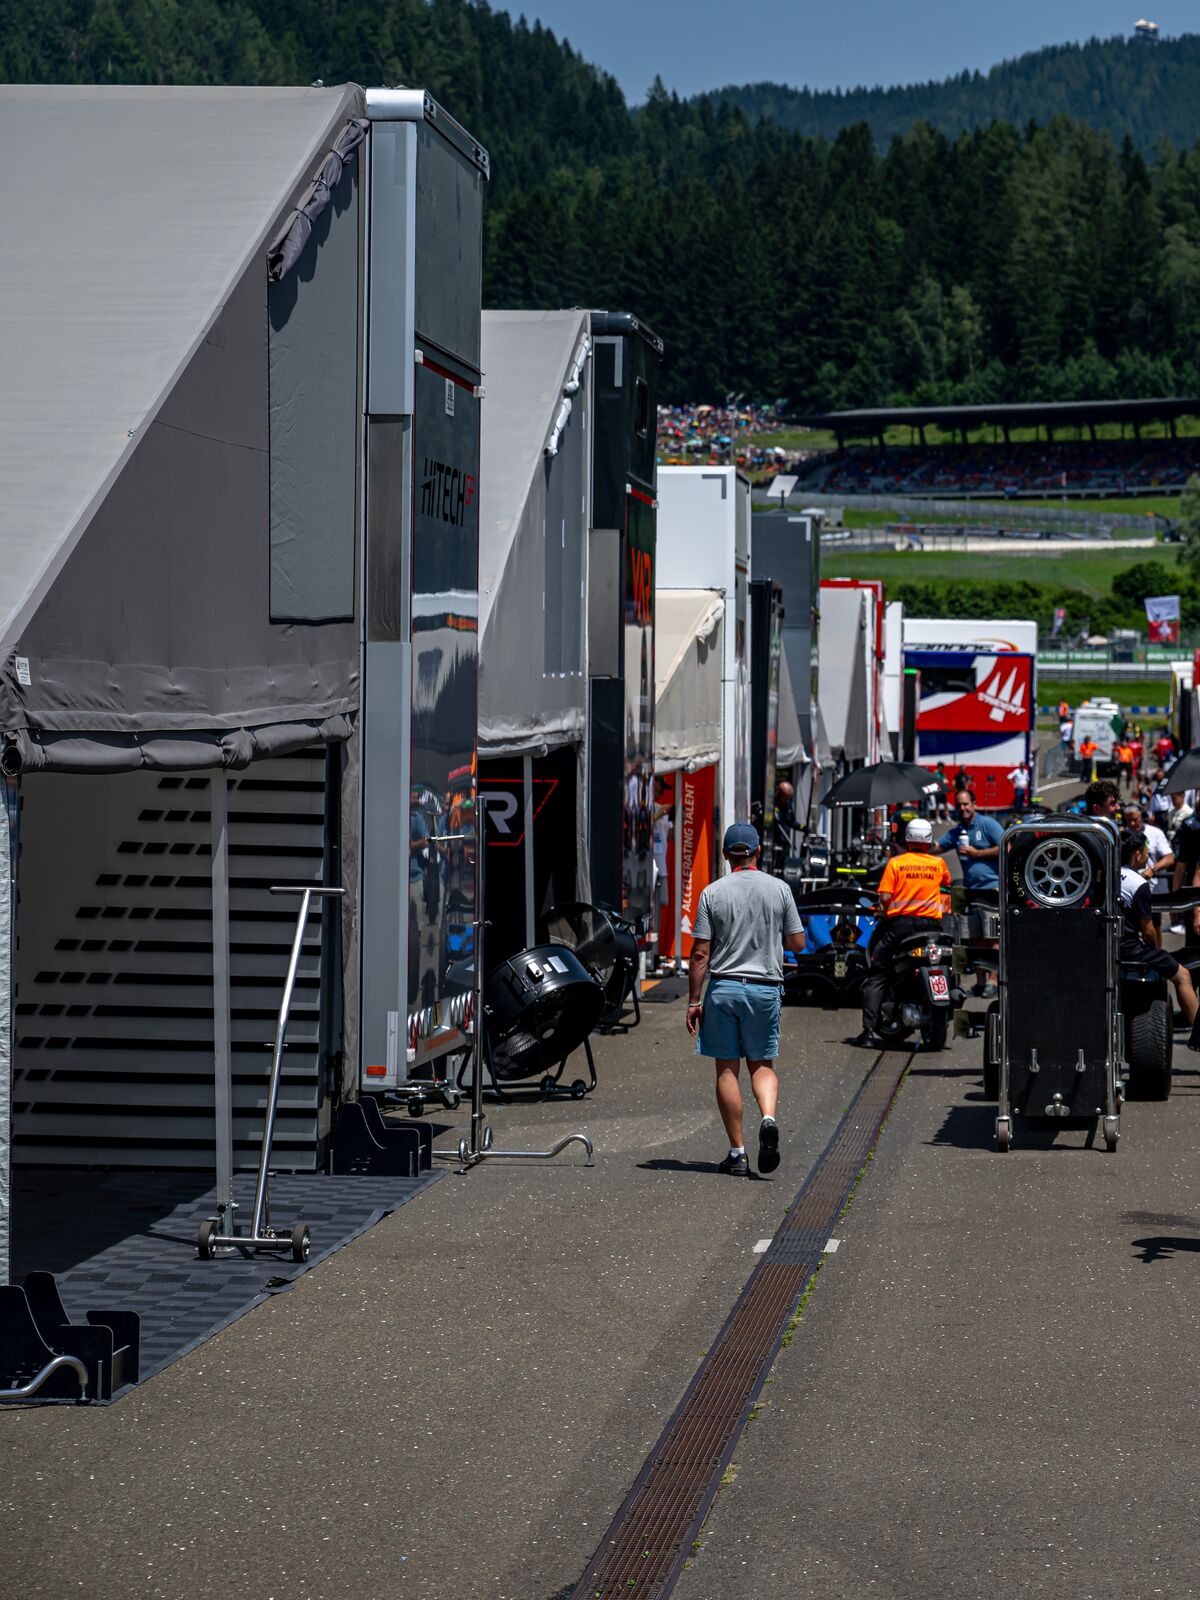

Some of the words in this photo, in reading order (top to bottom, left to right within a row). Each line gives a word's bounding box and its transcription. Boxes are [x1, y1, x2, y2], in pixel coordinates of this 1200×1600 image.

[683, 781, 695, 825] TALENT
[681, 826, 694, 913] ACCELERATING
[899, 864, 940, 873] MOTORSPORT
[905, 872, 935, 881] MARSHAL
